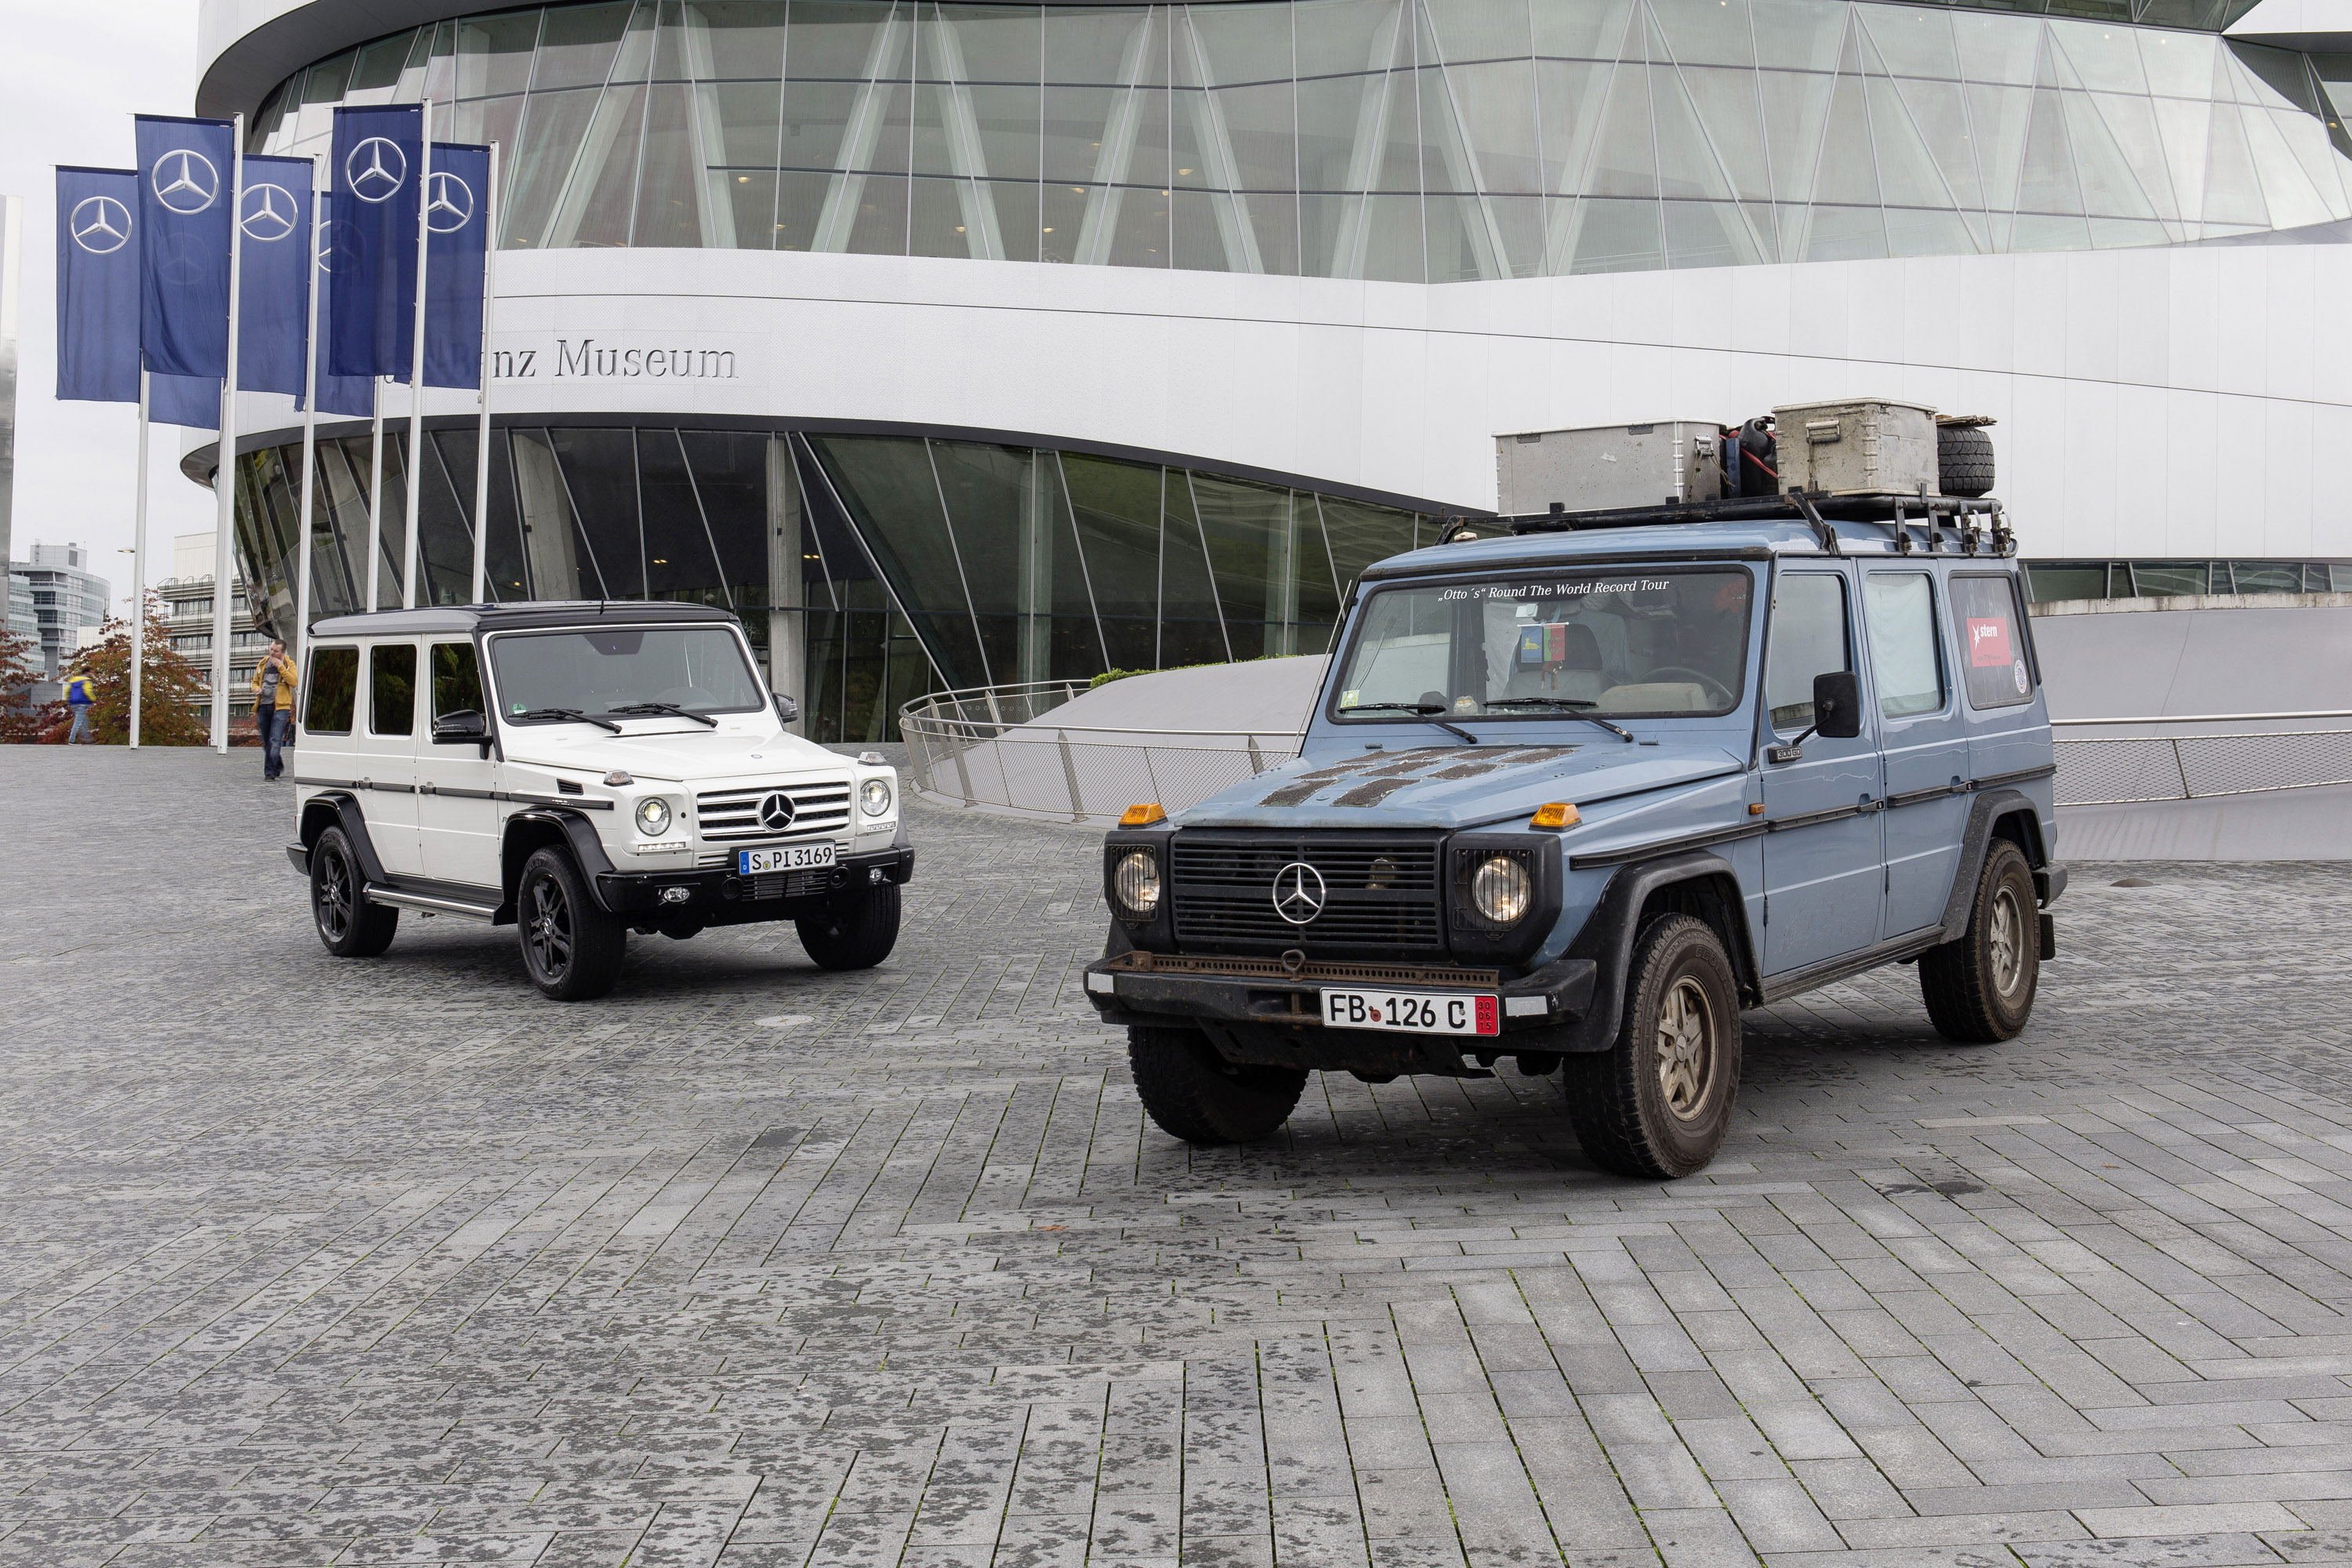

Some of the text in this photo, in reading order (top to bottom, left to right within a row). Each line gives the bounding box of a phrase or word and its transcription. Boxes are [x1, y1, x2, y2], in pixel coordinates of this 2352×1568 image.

[554, 339, 739, 379] Museum
[1488, 586, 1527, 598] Round
[1530, 585, 1552, 597] The
[1556, 583, 1592, 595] World
[1594, 580, 1637, 593] Record
[1640, 579, 1670, 591] Tour
[1980, 623, 1998, 637] stern
[752, 847, 833, 870] S PI 3169
[1329, 994, 1466, 1029] FB 126 C
[1478, 1001, 1490, 1010] 30
[1479, 1011, 1491, 1020] 06
[1479, 1022, 1492, 1030] 15
